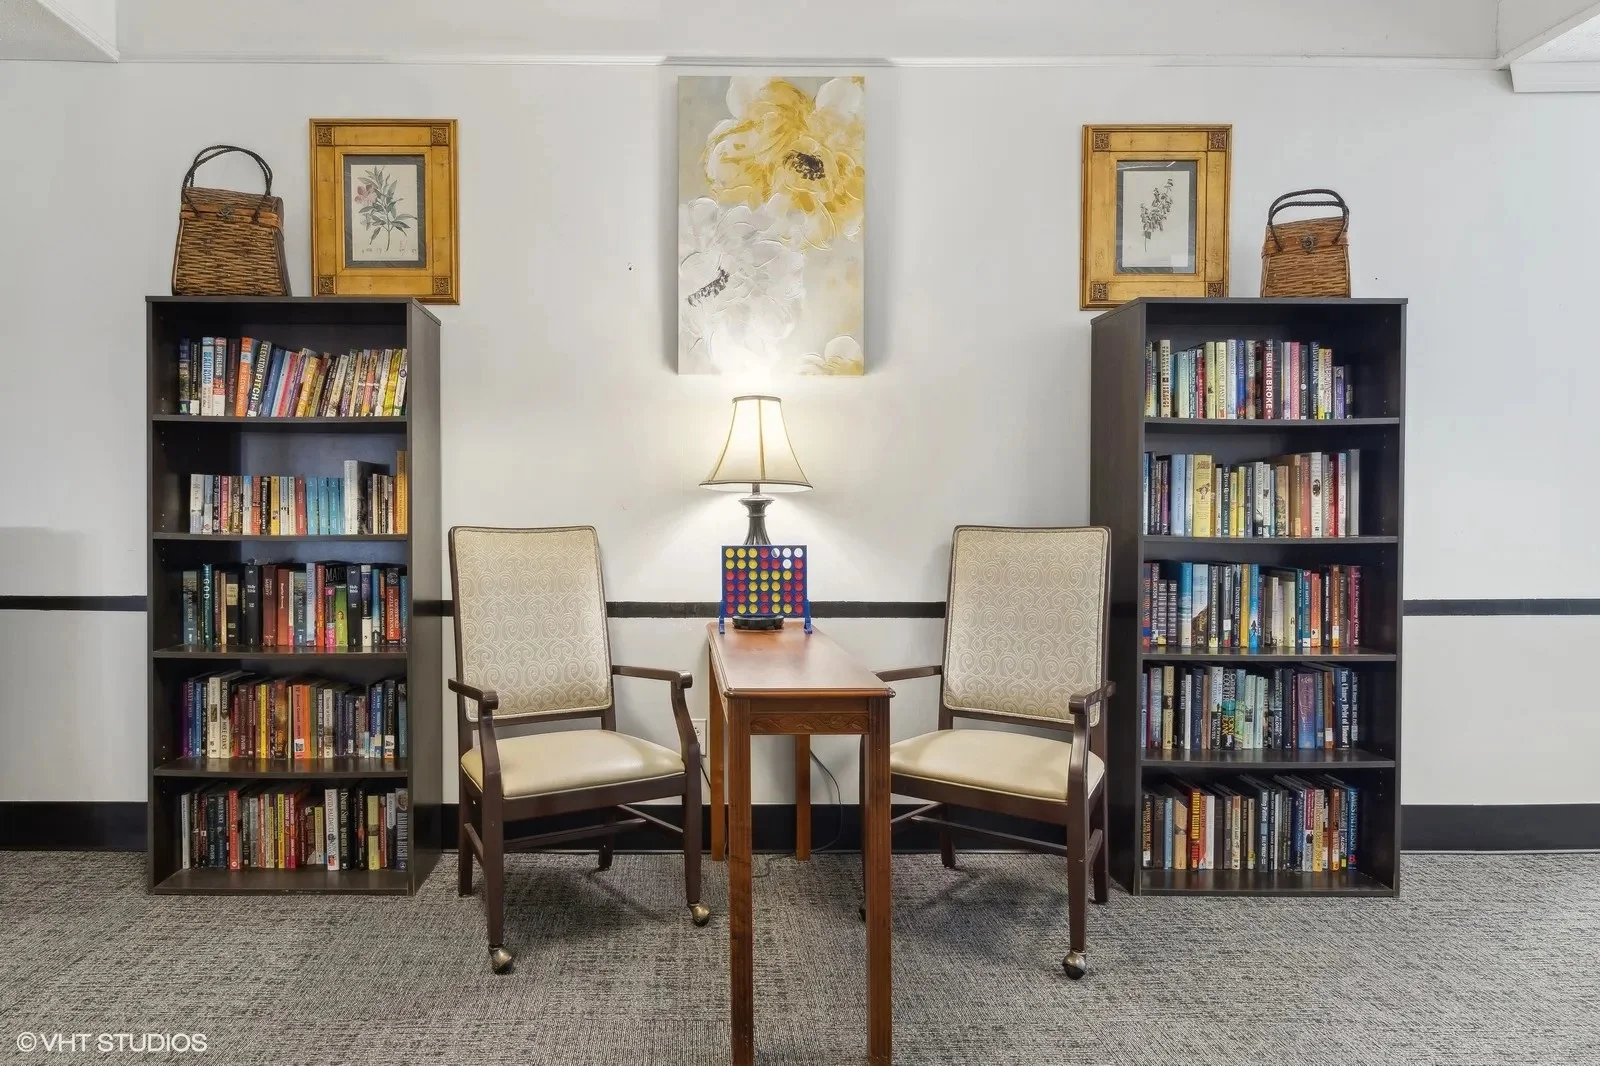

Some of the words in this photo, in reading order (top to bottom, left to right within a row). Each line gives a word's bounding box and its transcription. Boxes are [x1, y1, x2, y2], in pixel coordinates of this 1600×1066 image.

[203, 352, 212, 369] BEACH
[257, 344, 268, 373] ELEVATOR
[203, 369, 212, 384] ROAD
[251, 374, 262, 400] PITCH
[1340, 683, 1348, 702] Clancy
